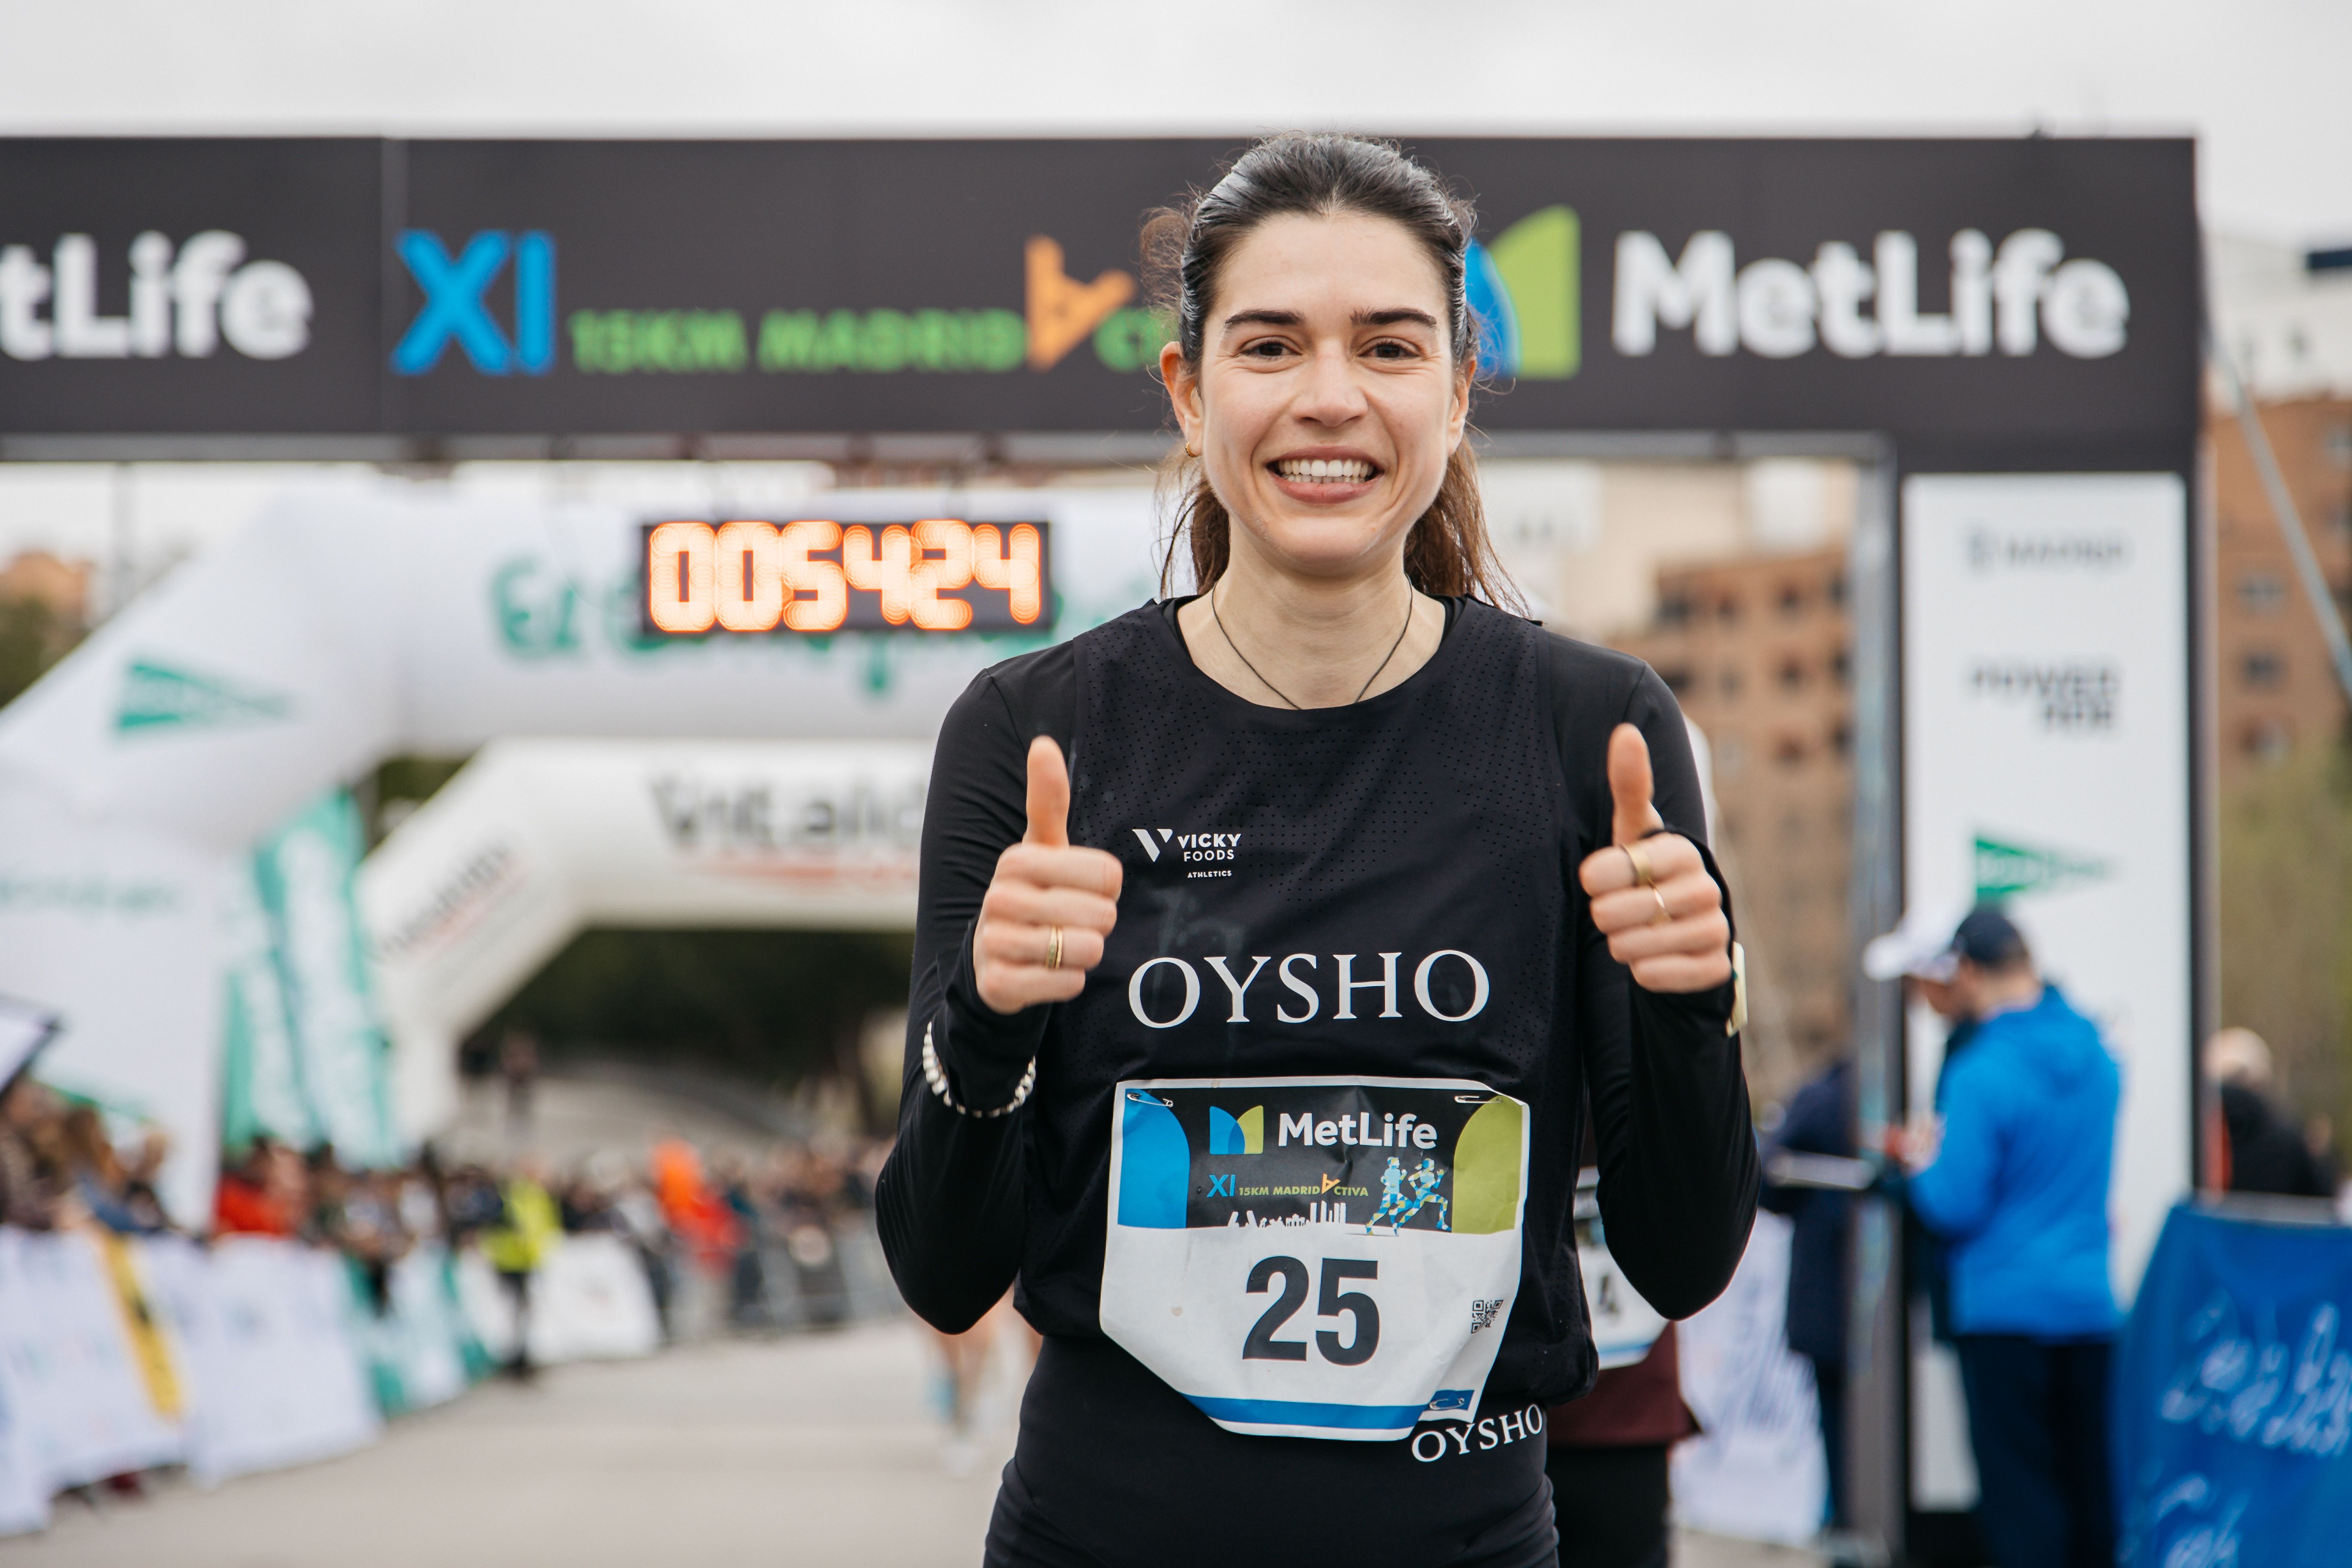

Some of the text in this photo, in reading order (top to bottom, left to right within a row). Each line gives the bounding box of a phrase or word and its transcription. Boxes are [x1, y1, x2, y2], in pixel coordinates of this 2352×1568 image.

[389, 228, 558, 377] XI
[1611, 228, 2130, 358] MetLife
[569, 308, 747, 373] 15KM
[757, 308, 1030, 373] MADRID
[1177, 833, 1241, 849] VICKY
[1184, 849, 1234, 862] FOODS
[1187, 870, 1232, 878] ATHLETICS
[1128, 949, 1489, 1029] OYSHO
[1278, 1112, 1438, 1149] MetLife
[1207, 1174, 1236, 1197] XI
[1239, 1186, 1269, 1196] 15KM
[1273, 1186, 1320, 1196] MADRID
[1242, 1255, 1380, 1366] 25
[1412, 1403, 1543, 1462] OYSHO
